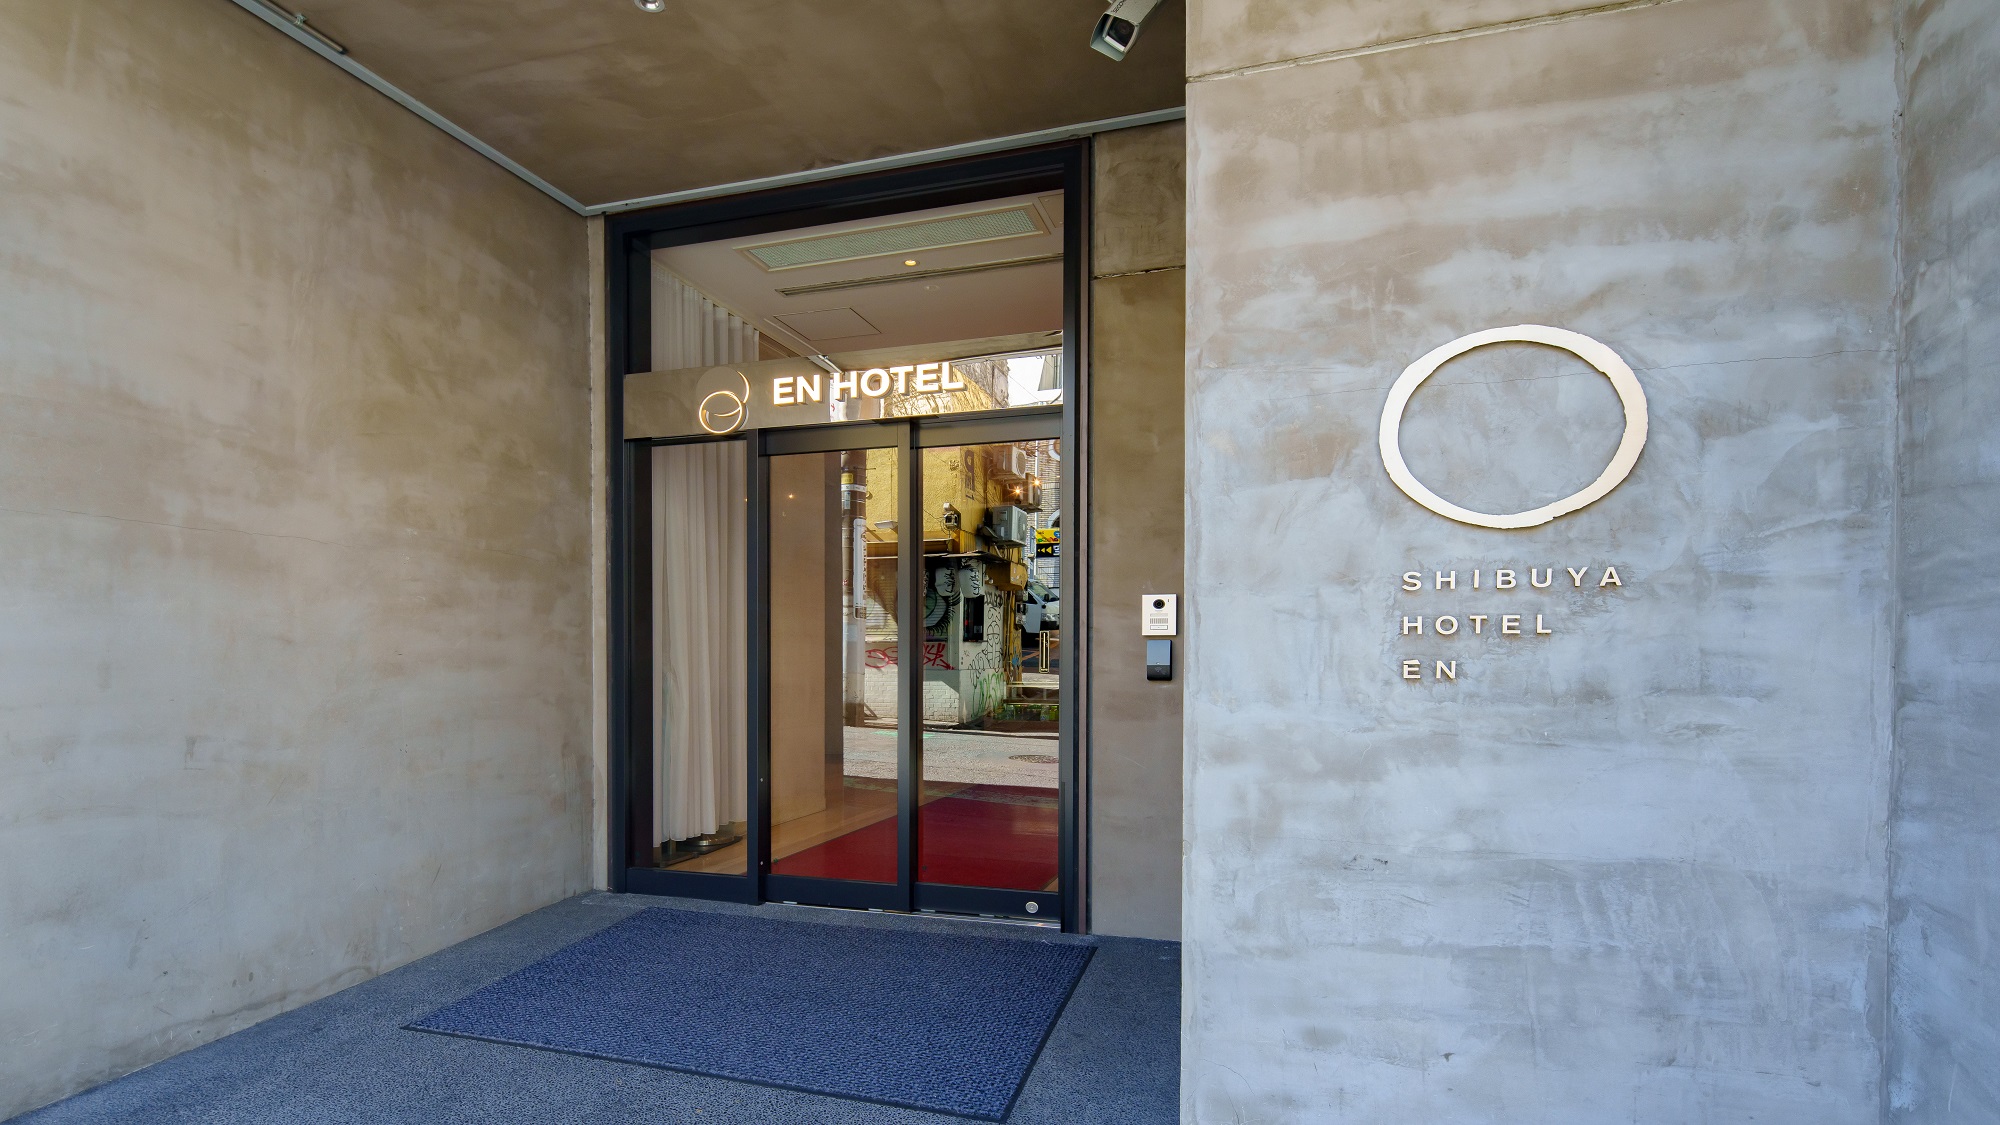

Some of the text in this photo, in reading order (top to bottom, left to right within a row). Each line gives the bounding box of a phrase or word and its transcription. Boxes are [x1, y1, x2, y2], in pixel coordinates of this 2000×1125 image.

[772, 361, 966, 406] EN HOTEL
[1401, 566, 1623, 592] SHIBUYA
[1402, 614, 1553, 636] HOTEL
[1402, 659, 1457, 680] EN
